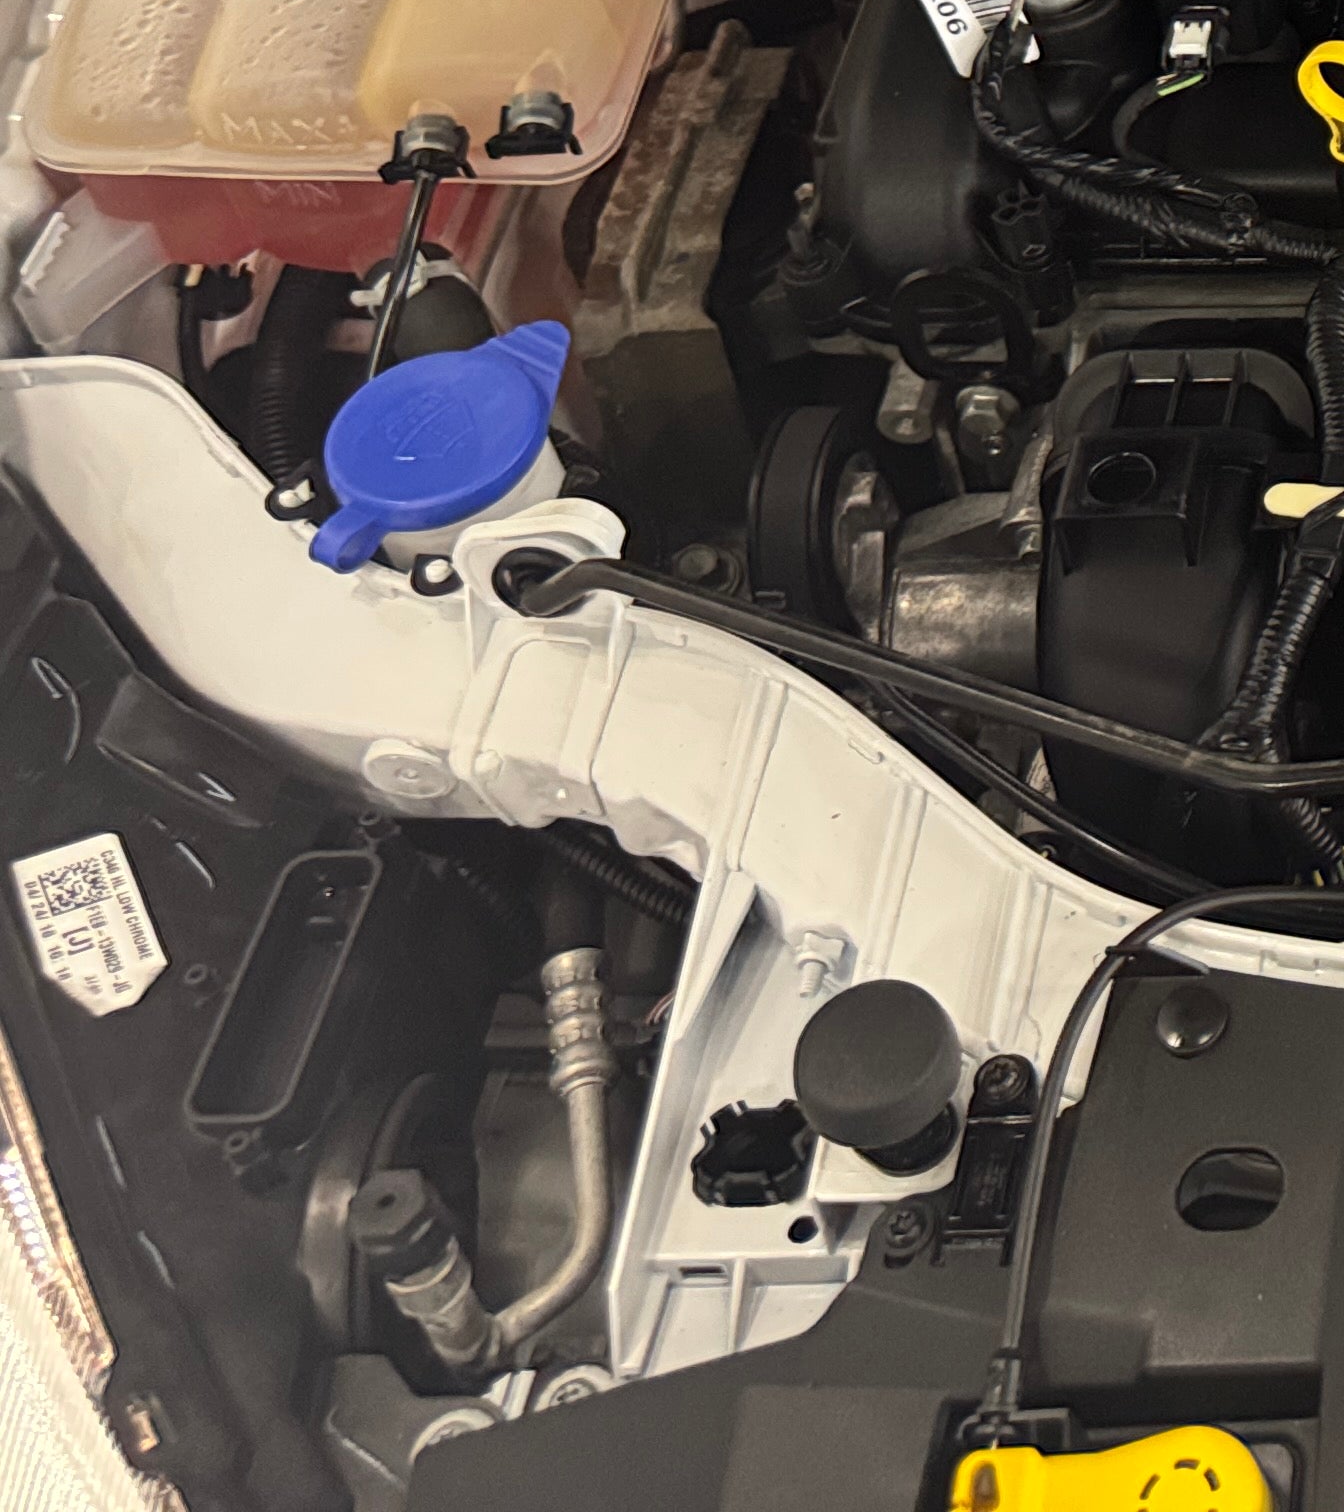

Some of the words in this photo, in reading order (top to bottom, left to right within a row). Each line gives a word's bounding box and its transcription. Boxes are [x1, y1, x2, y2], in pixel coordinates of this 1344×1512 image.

[221, 113, 332, 143] MAX
[254, 181, 342, 207] MIN
[116, 891, 135, 915] LOW
[126, 916, 155, 960] CHROME
